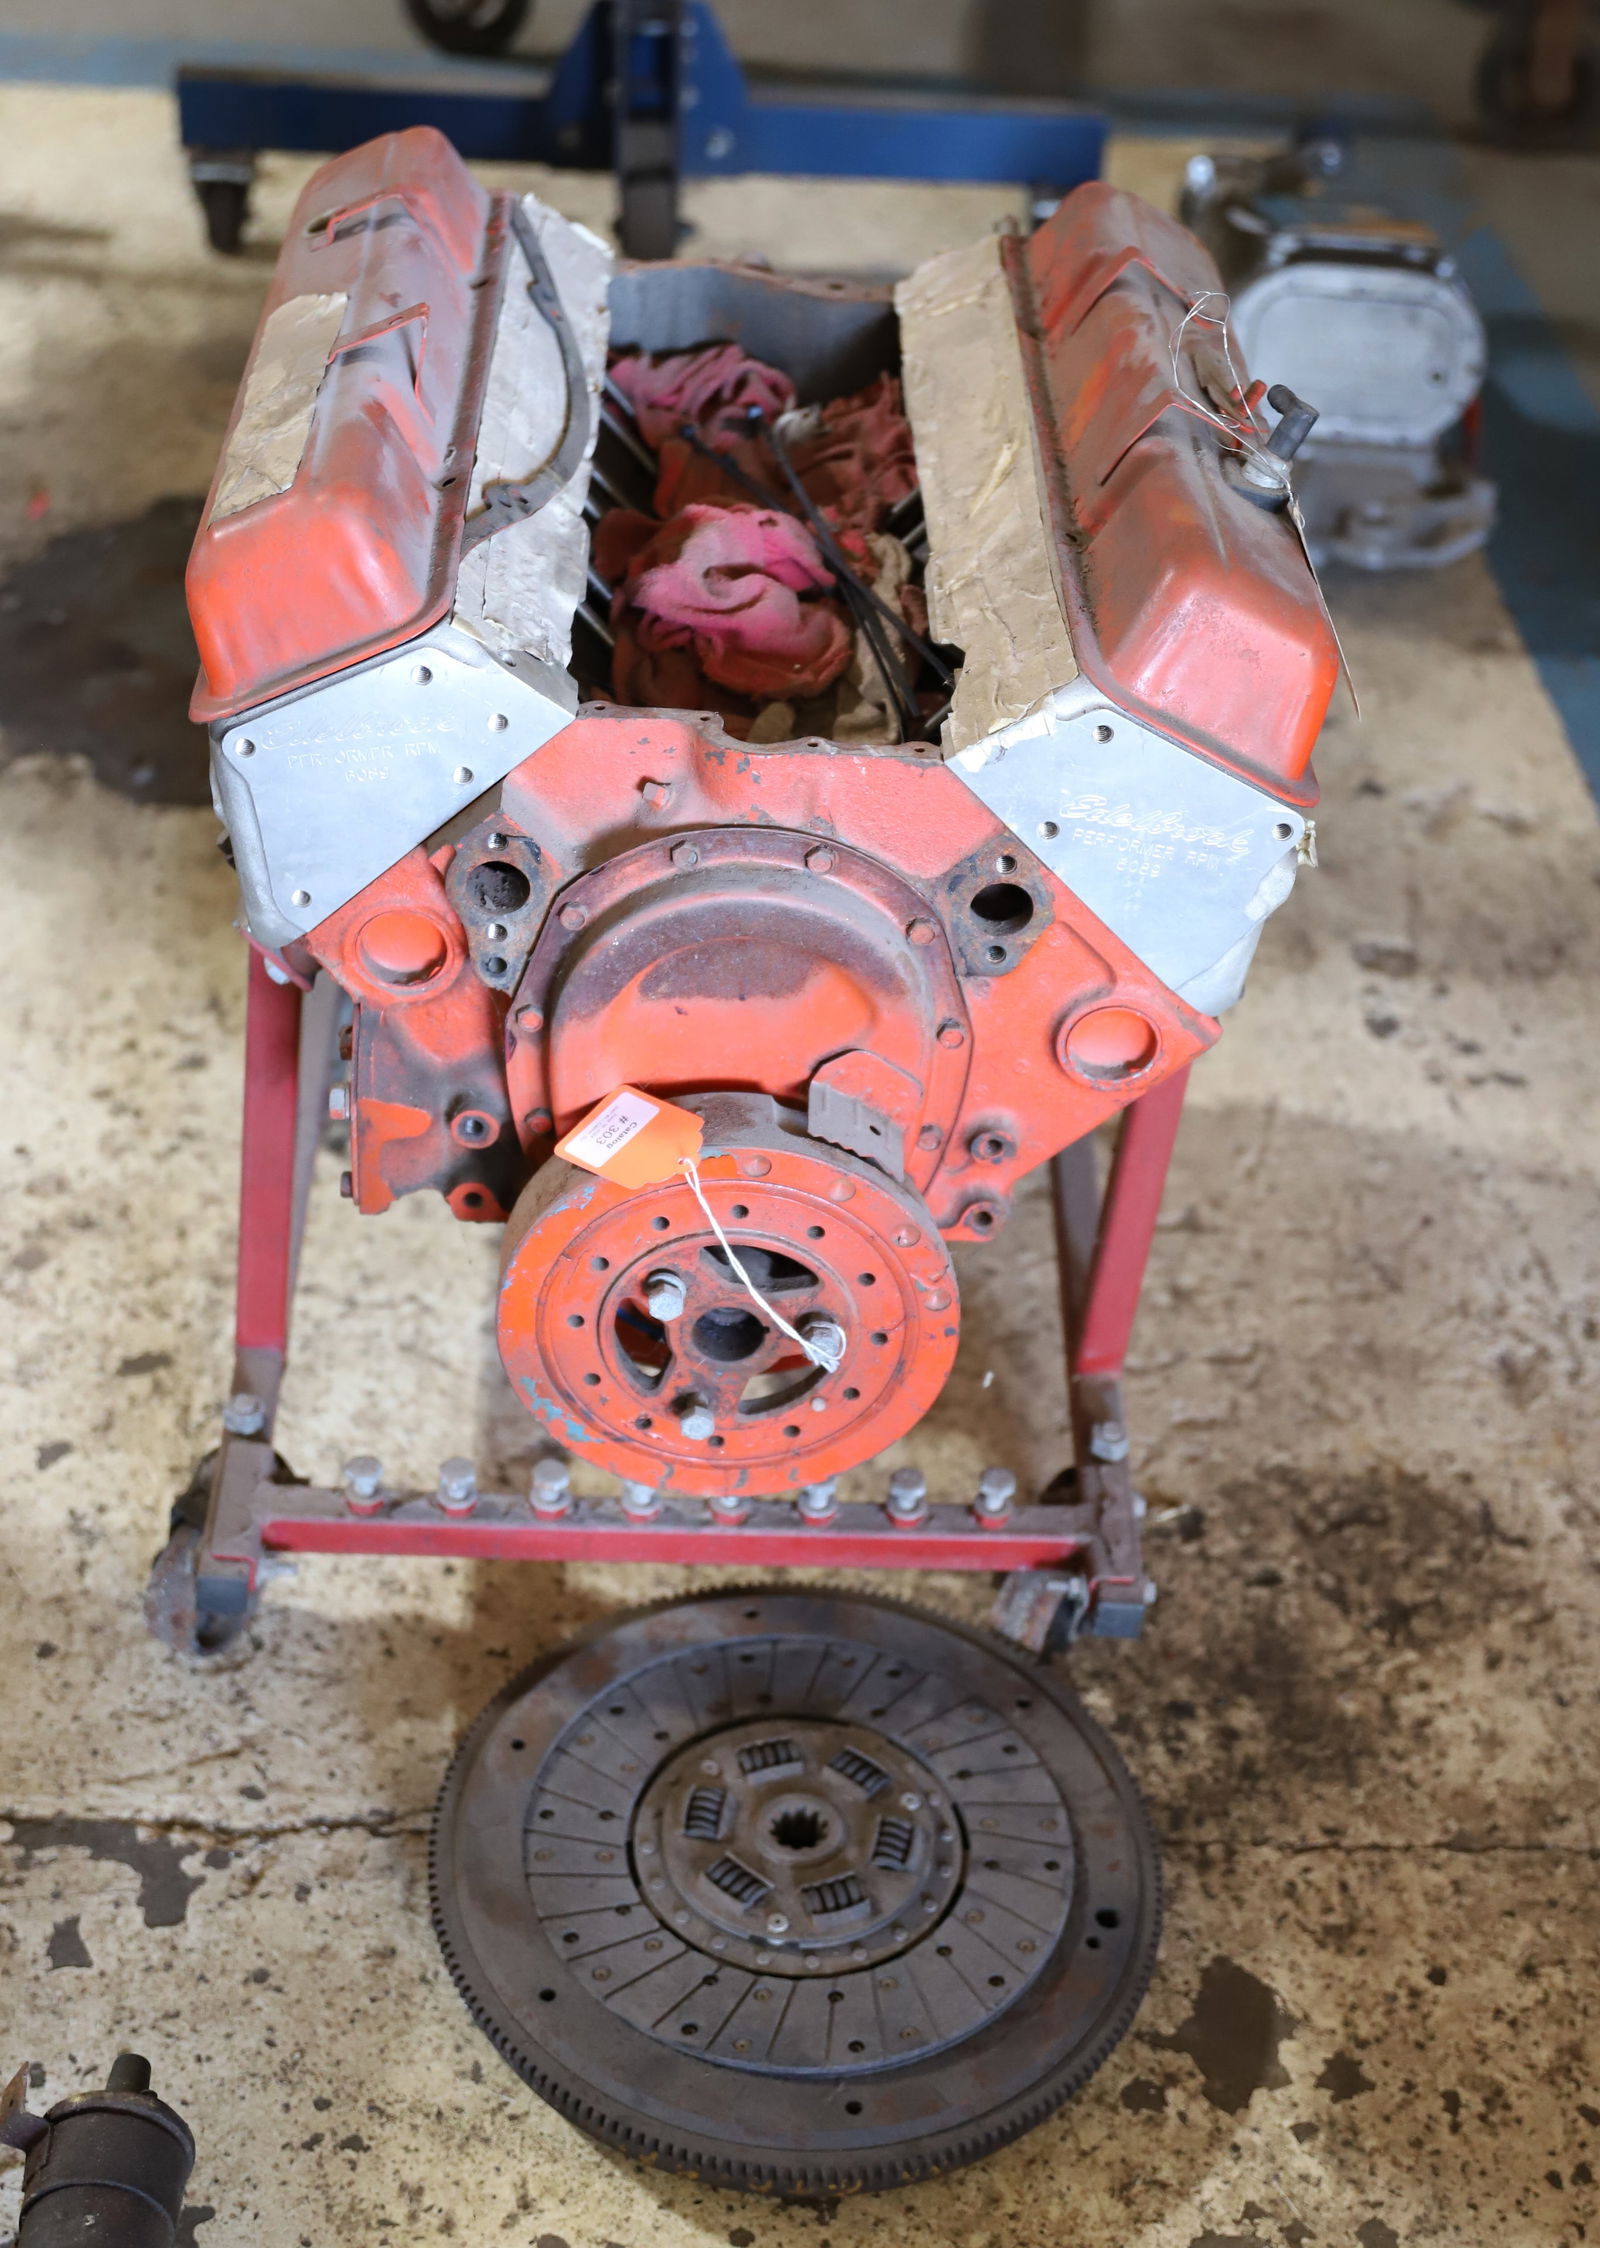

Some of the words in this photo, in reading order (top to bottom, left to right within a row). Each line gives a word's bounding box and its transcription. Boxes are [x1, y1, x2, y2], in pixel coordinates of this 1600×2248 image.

[404, 741, 442, 758] RPM
[1058, 793, 1255, 866] Edelbrock
[1072, 827, 1176, 862] PERFORMER
[1184, 849, 1222, 873] RPM
[618, 1115, 629, 1125] #
[595, 1124, 620, 1146] 303
[606, 1121, 638, 1150] Catalog
